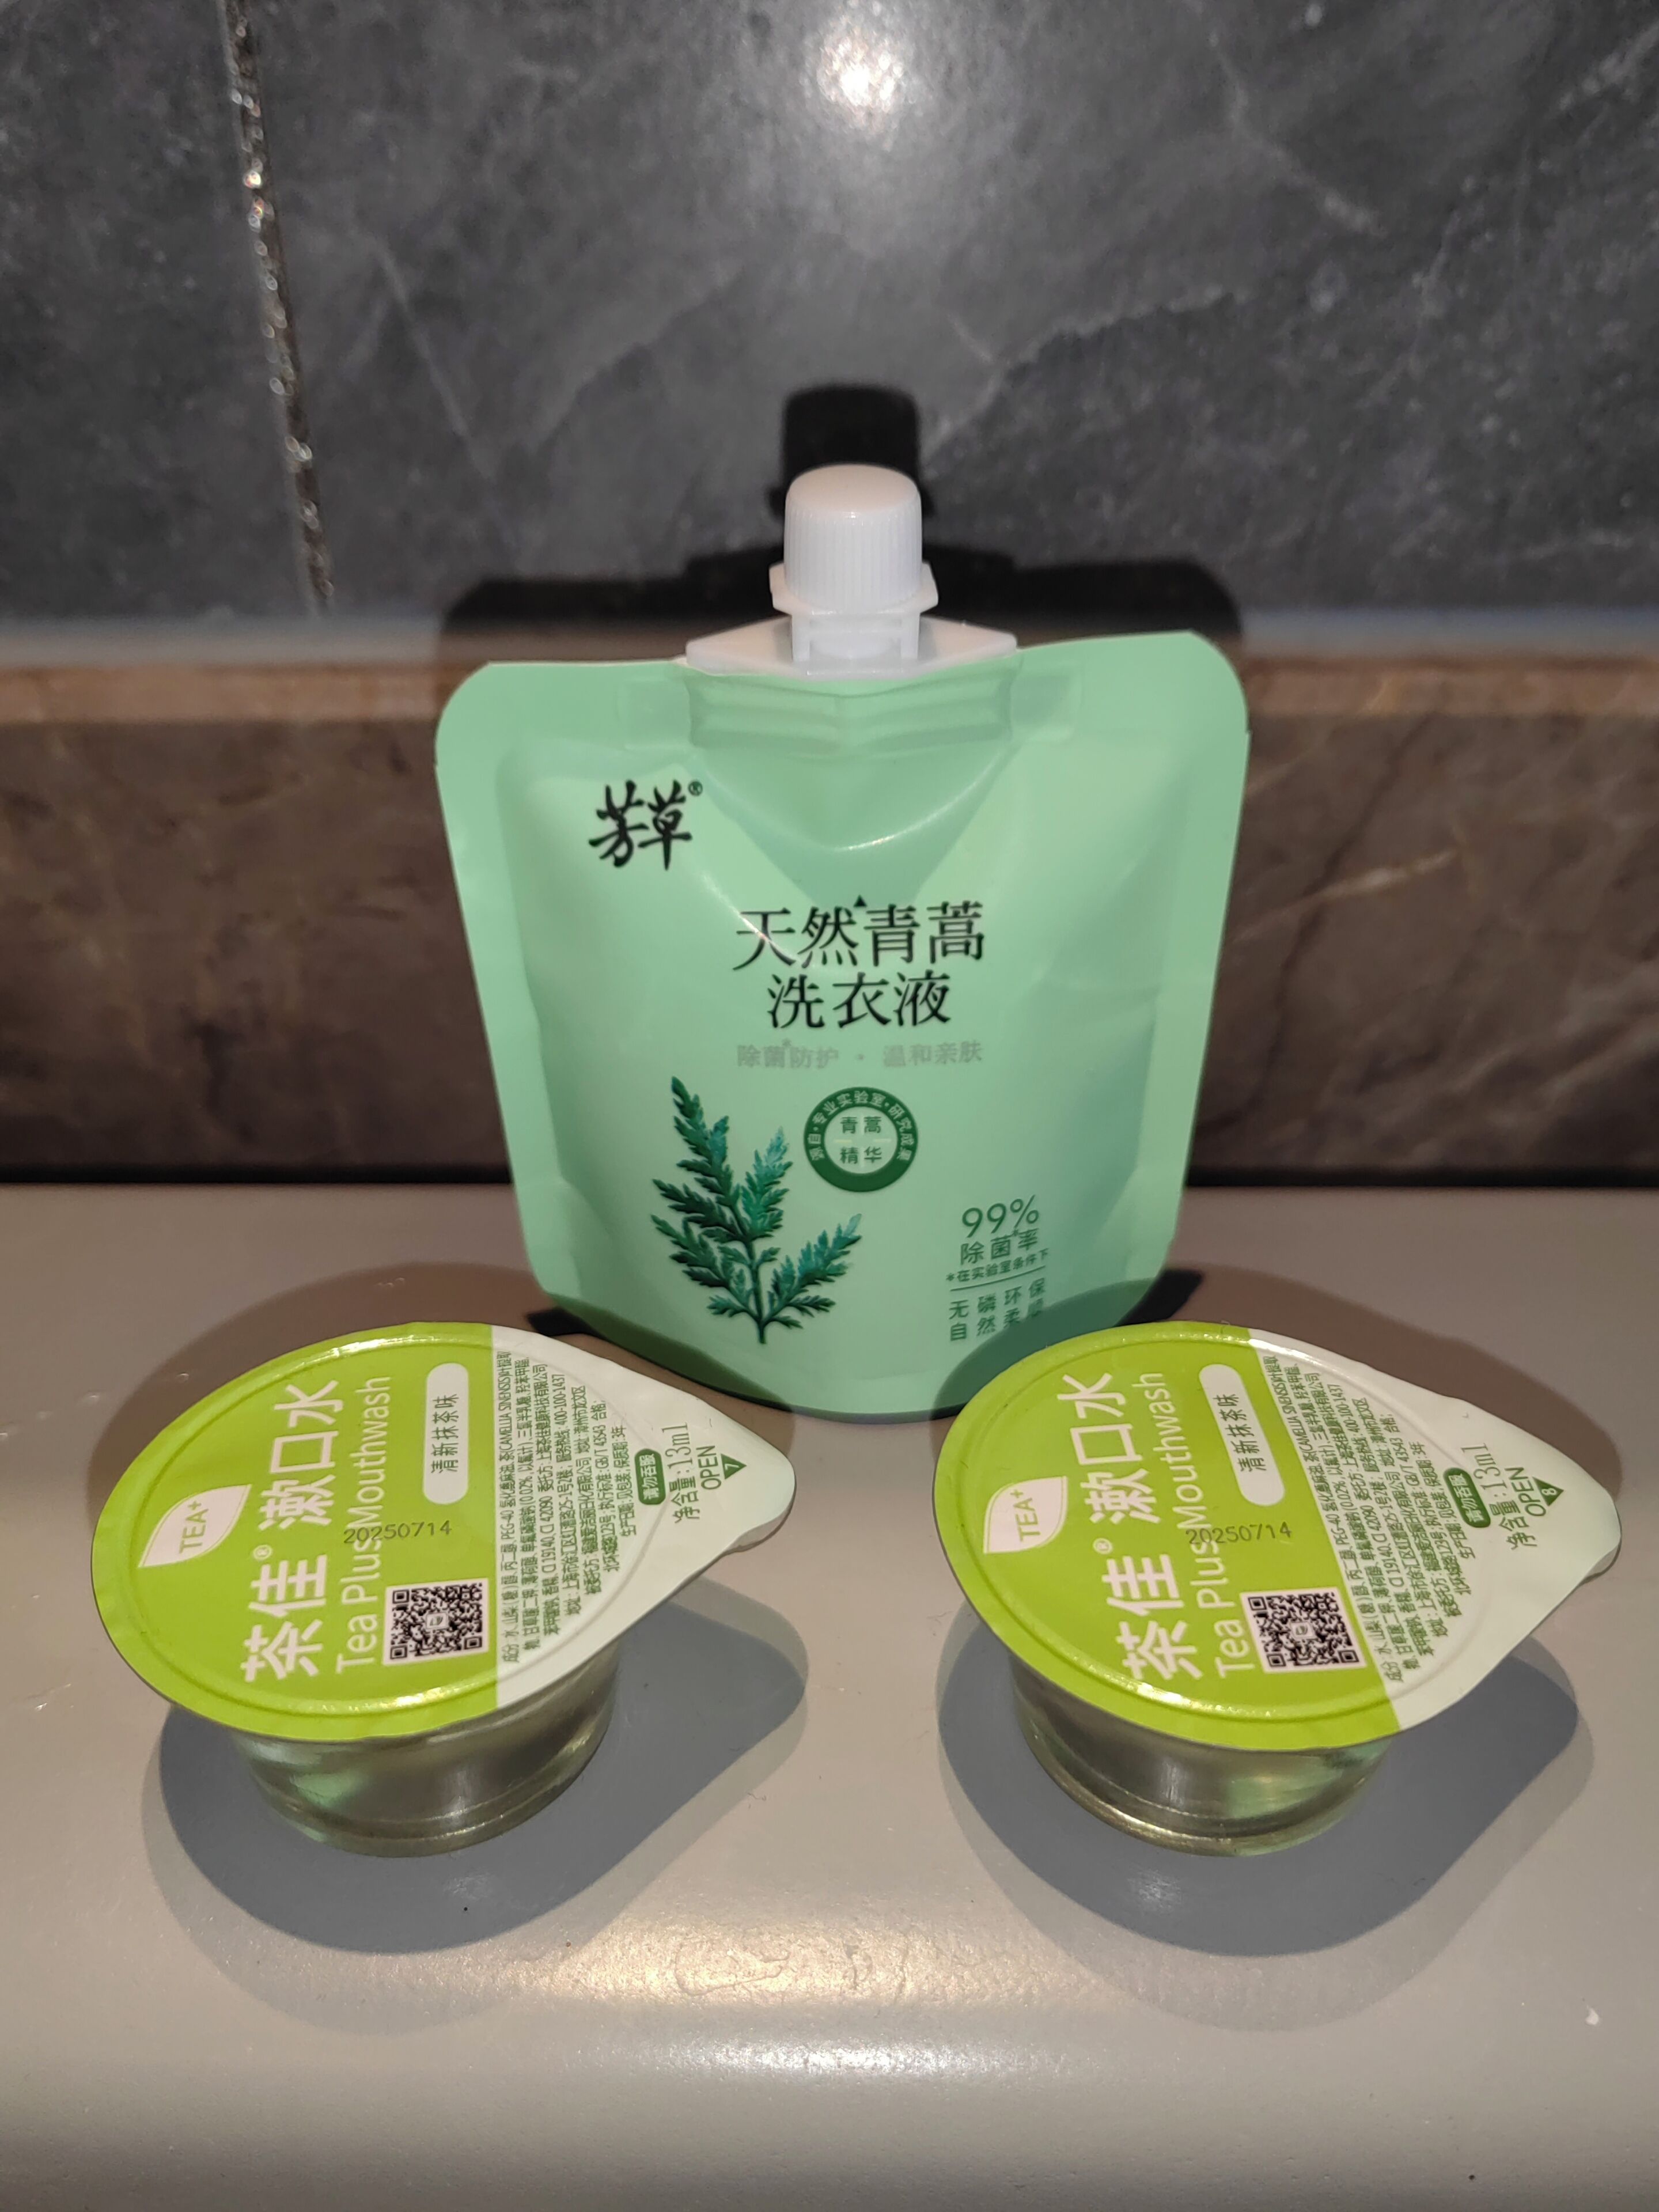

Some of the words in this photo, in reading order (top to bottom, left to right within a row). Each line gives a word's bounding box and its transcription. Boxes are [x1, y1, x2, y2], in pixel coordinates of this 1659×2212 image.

[733, 900, 985, 971] 天然青蒿
[767, 969, 952, 1029] 洗衣液
[961, 1194, 1039, 1238] 99%
[258, 1379, 344, 1531] 漱口水
[346, 1376, 392, 1528] Mouthwash
[431, 1393, 460, 1474] 清新抹茶味
[593, 1425, 607, 1446] 43543
[1057, 1372, 1161, 1525] 漱口水
[1132, 1372, 1207, 1532] Mouthwash
[1220, 1394, 1267, 1472] 清新抹茶味
[1389, 1437, 1410, 1462] 43543
[639, 1453, 661, 1501] 请勿吞服
[696, 1445, 722, 1490] OPEN
[1503, 1466, 1547, 1517] OPEN
[1542, 1487, 1556, 1495] 8
[539, 1495, 554, 1522] 42090
[1359, 1503, 1382, 1533] 42090
[1448, 1473, 1486, 1522] 请勿吞服
[344, 1520, 452, 1544] 20250714
[1185, 1521, 1292, 1546] 20250714
[340, 1535, 382, 1606] Plus
[1190, 1538, 1234, 1609] Plus
[335, 1613, 378, 1675] Tea
[1214, 1620, 1255, 1678] Tea
